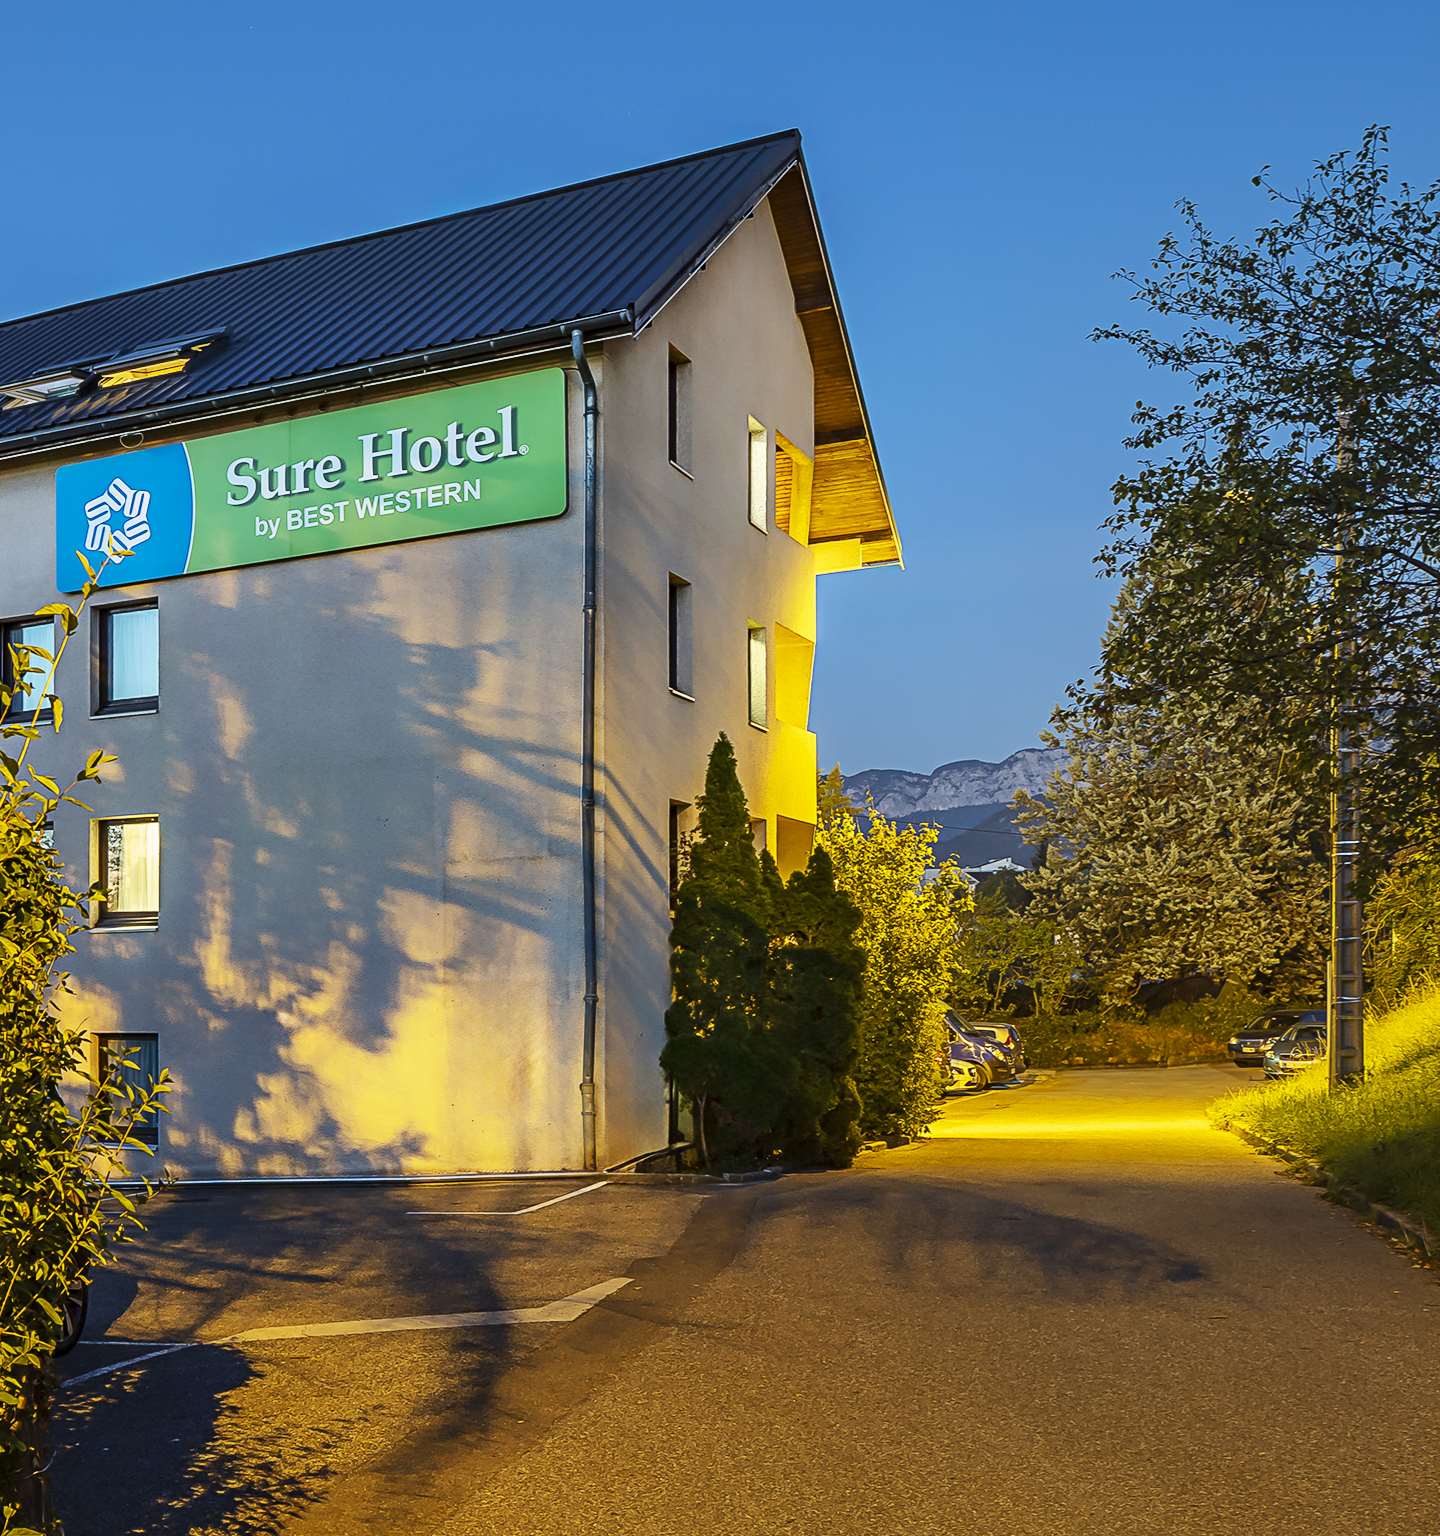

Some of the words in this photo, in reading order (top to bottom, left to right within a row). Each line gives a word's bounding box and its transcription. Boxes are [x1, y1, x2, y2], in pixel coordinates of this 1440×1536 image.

[226, 455, 344, 506] Sure
[255, 516, 281, 539] by
[286, 500, 350, 532] BEST
[354, 478, 481, 519] WESTERN
